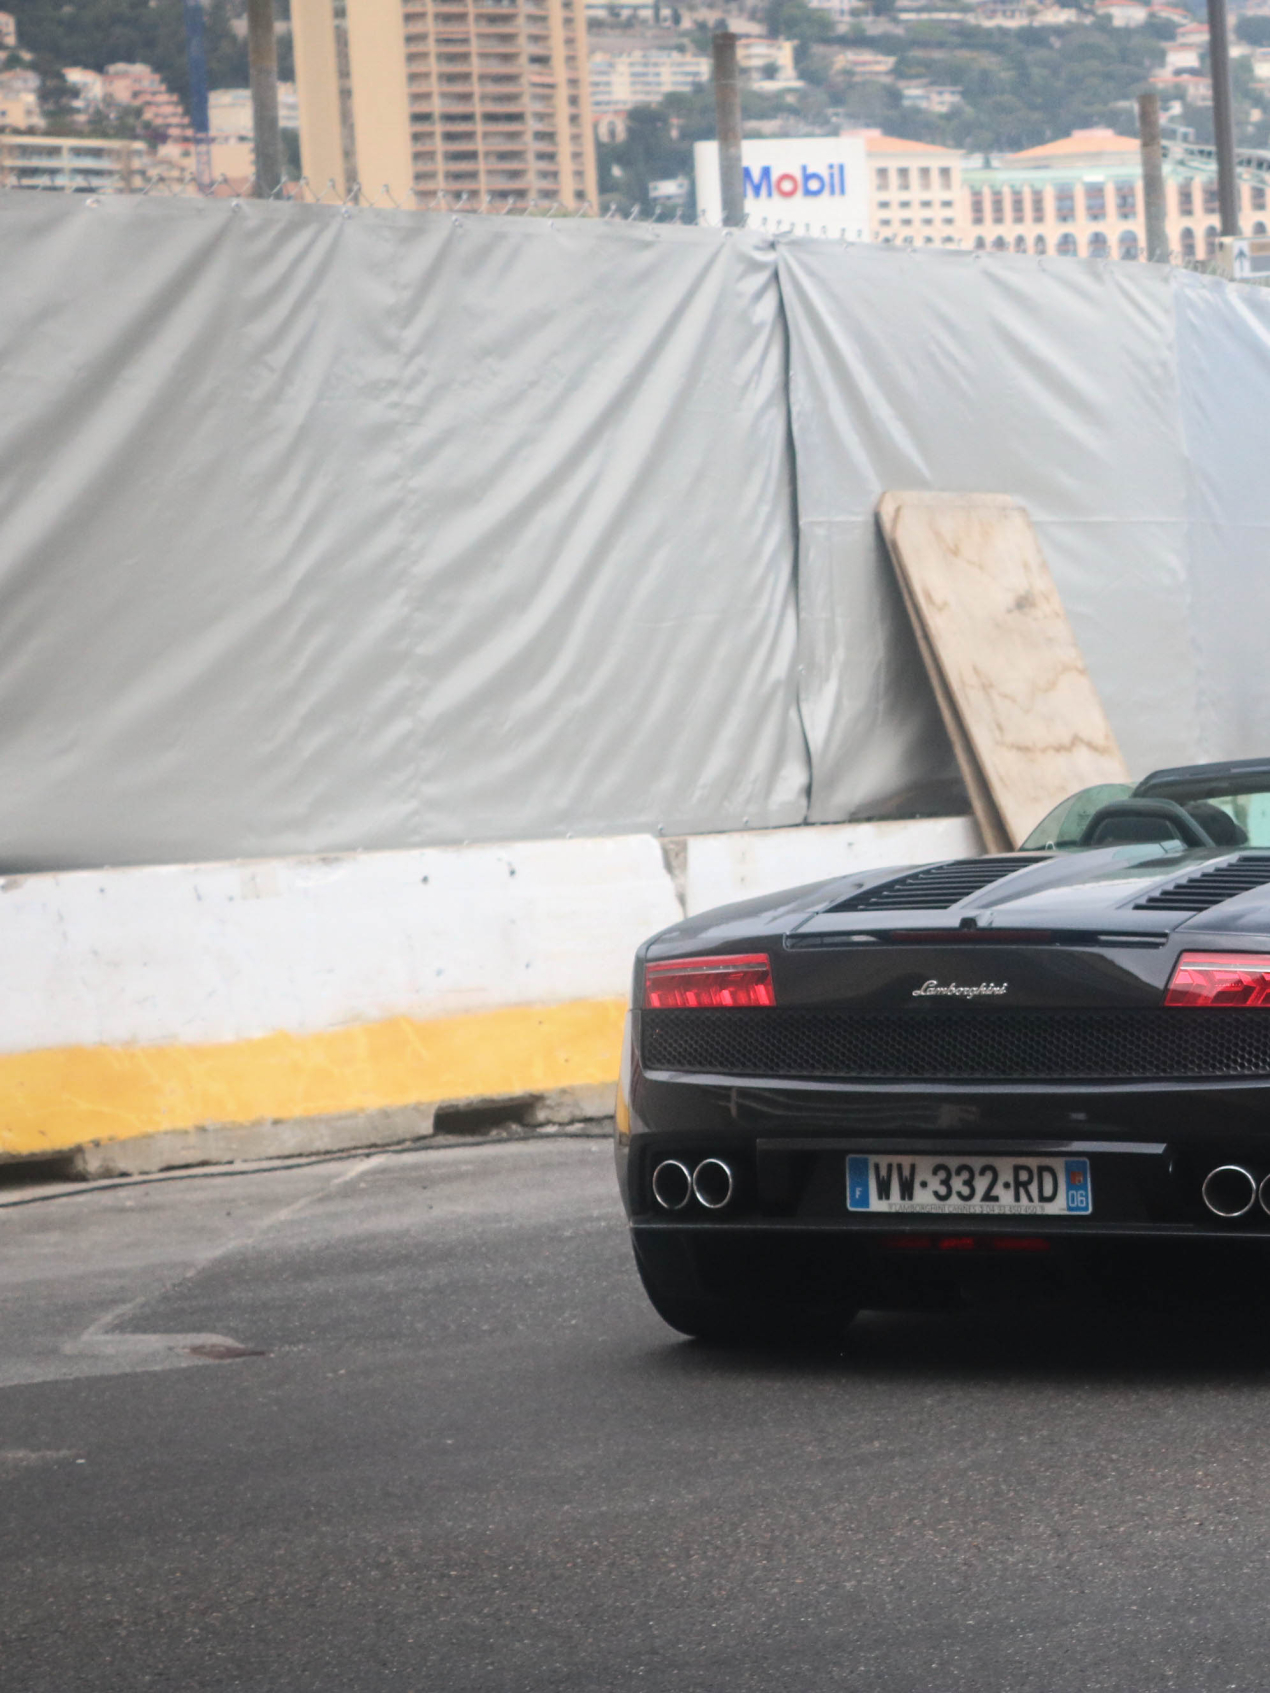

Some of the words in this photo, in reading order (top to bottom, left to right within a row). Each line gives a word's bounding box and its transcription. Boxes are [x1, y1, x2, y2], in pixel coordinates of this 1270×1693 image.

[743, 164, 846, 198] Mobil
[912, 980, 1008, 999] Lamborghini
[1068, 1190, 1086, 1208] 06
